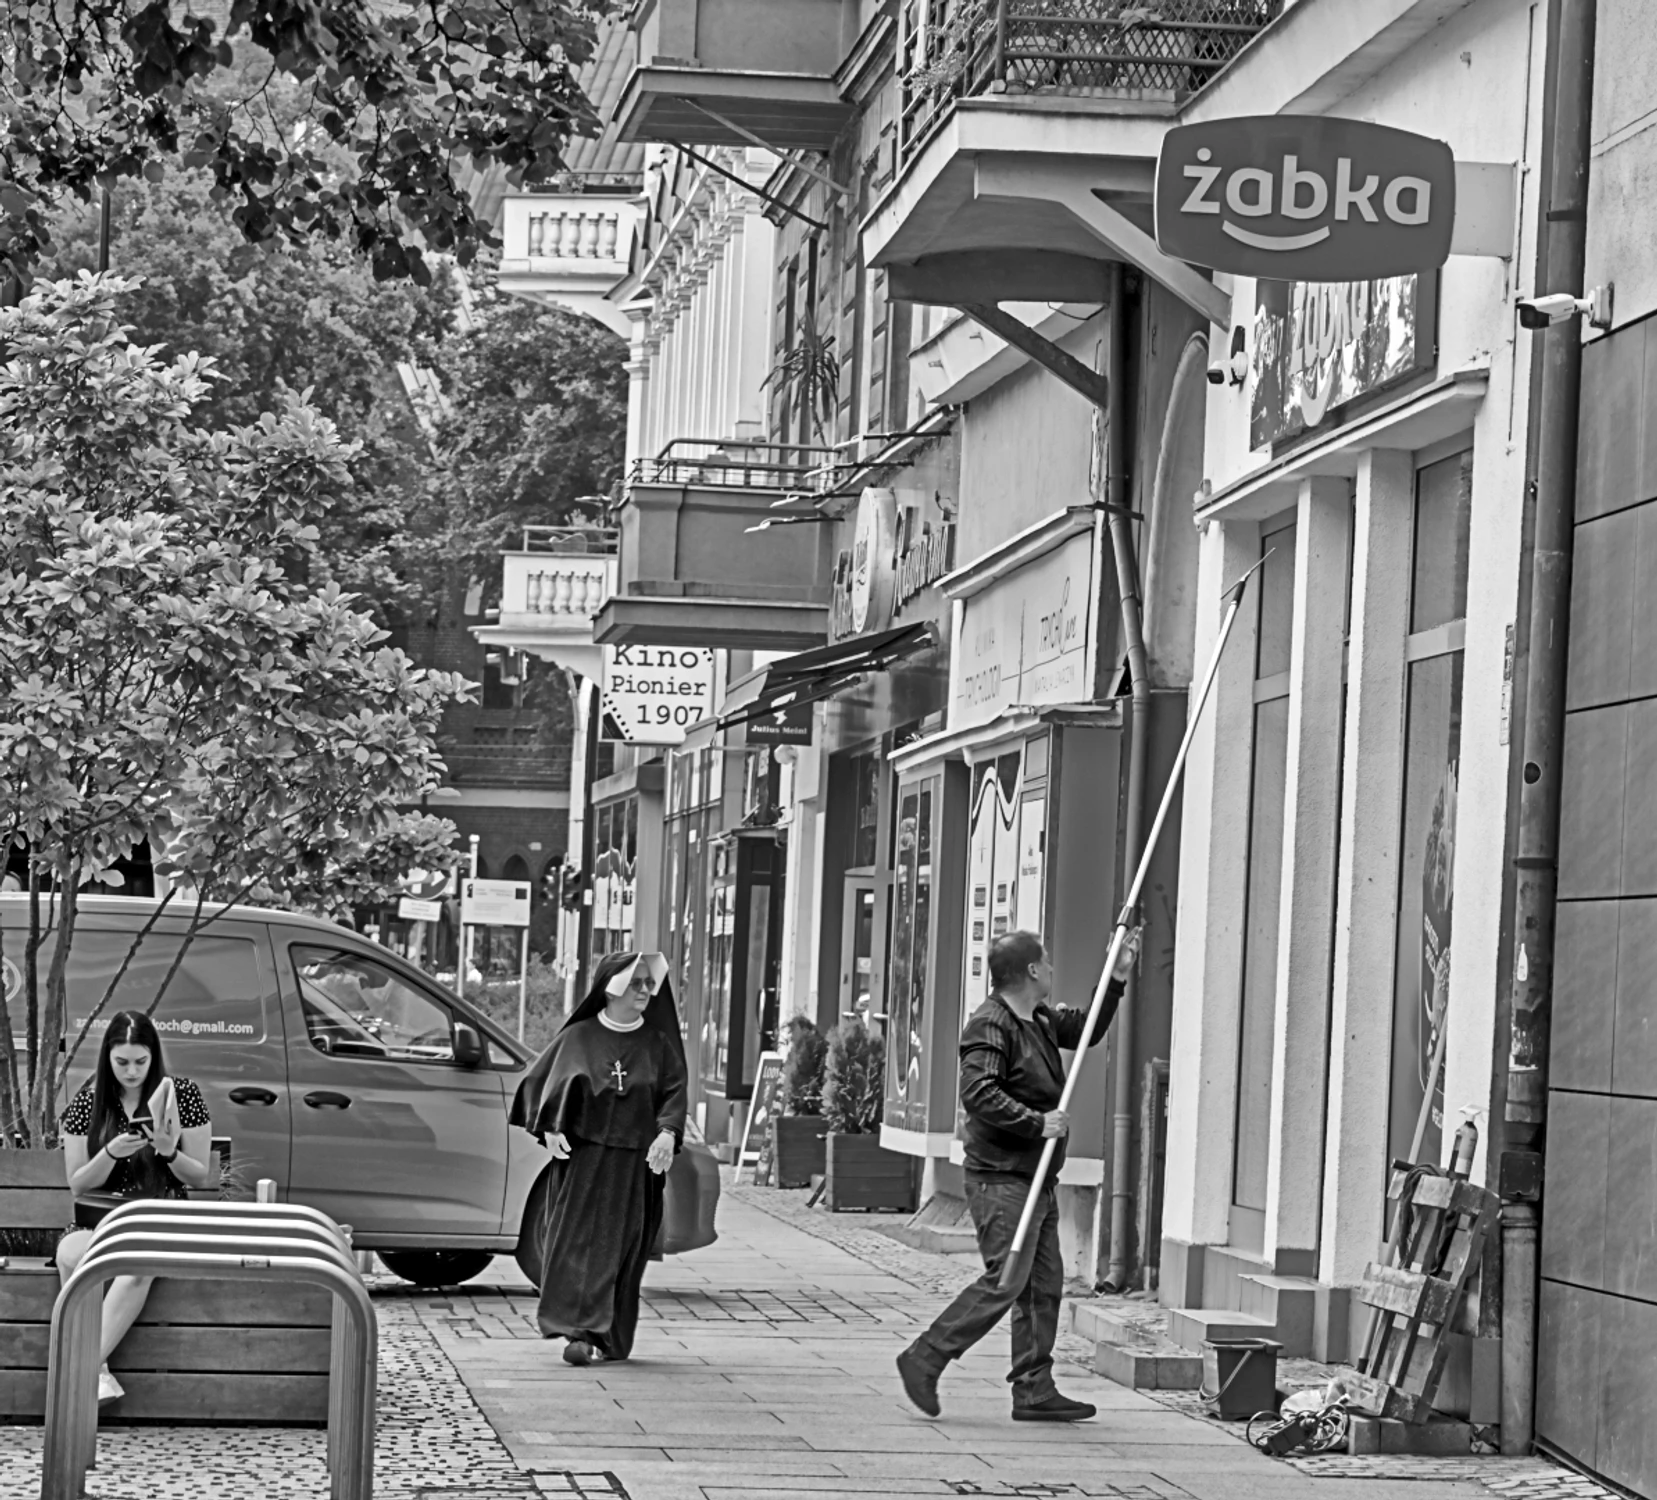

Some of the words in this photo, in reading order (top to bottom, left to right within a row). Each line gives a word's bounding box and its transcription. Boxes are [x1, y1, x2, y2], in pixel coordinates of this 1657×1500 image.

[1180, 147, 1431, 225] żabka
[612, 645, 699, 669] Kino
[611, 674, 707, 696] Pionier
[637, 704, 703, 726] 1907
